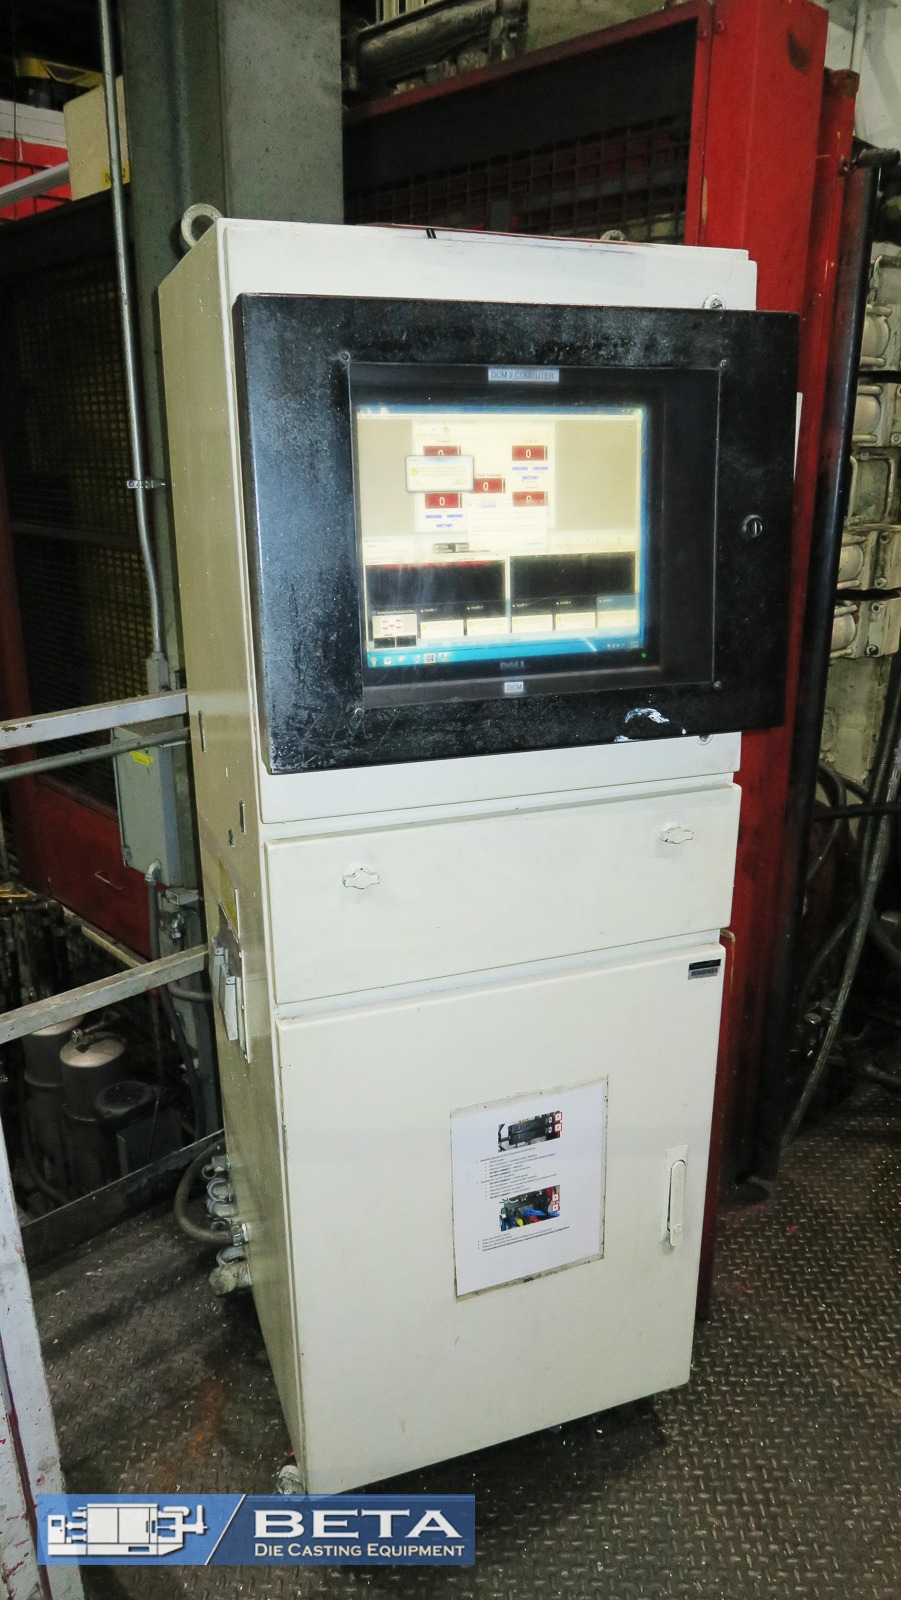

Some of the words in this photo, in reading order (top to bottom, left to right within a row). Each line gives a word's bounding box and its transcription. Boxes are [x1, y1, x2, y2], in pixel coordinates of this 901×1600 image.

[491, 371, 507, 379] DCM
[514, 371, 554, 380] COMPUTER
[525, 449, 531, 458] 0
[482, 482, 489, 491] 0
[439, 496, 445, 506] 0
